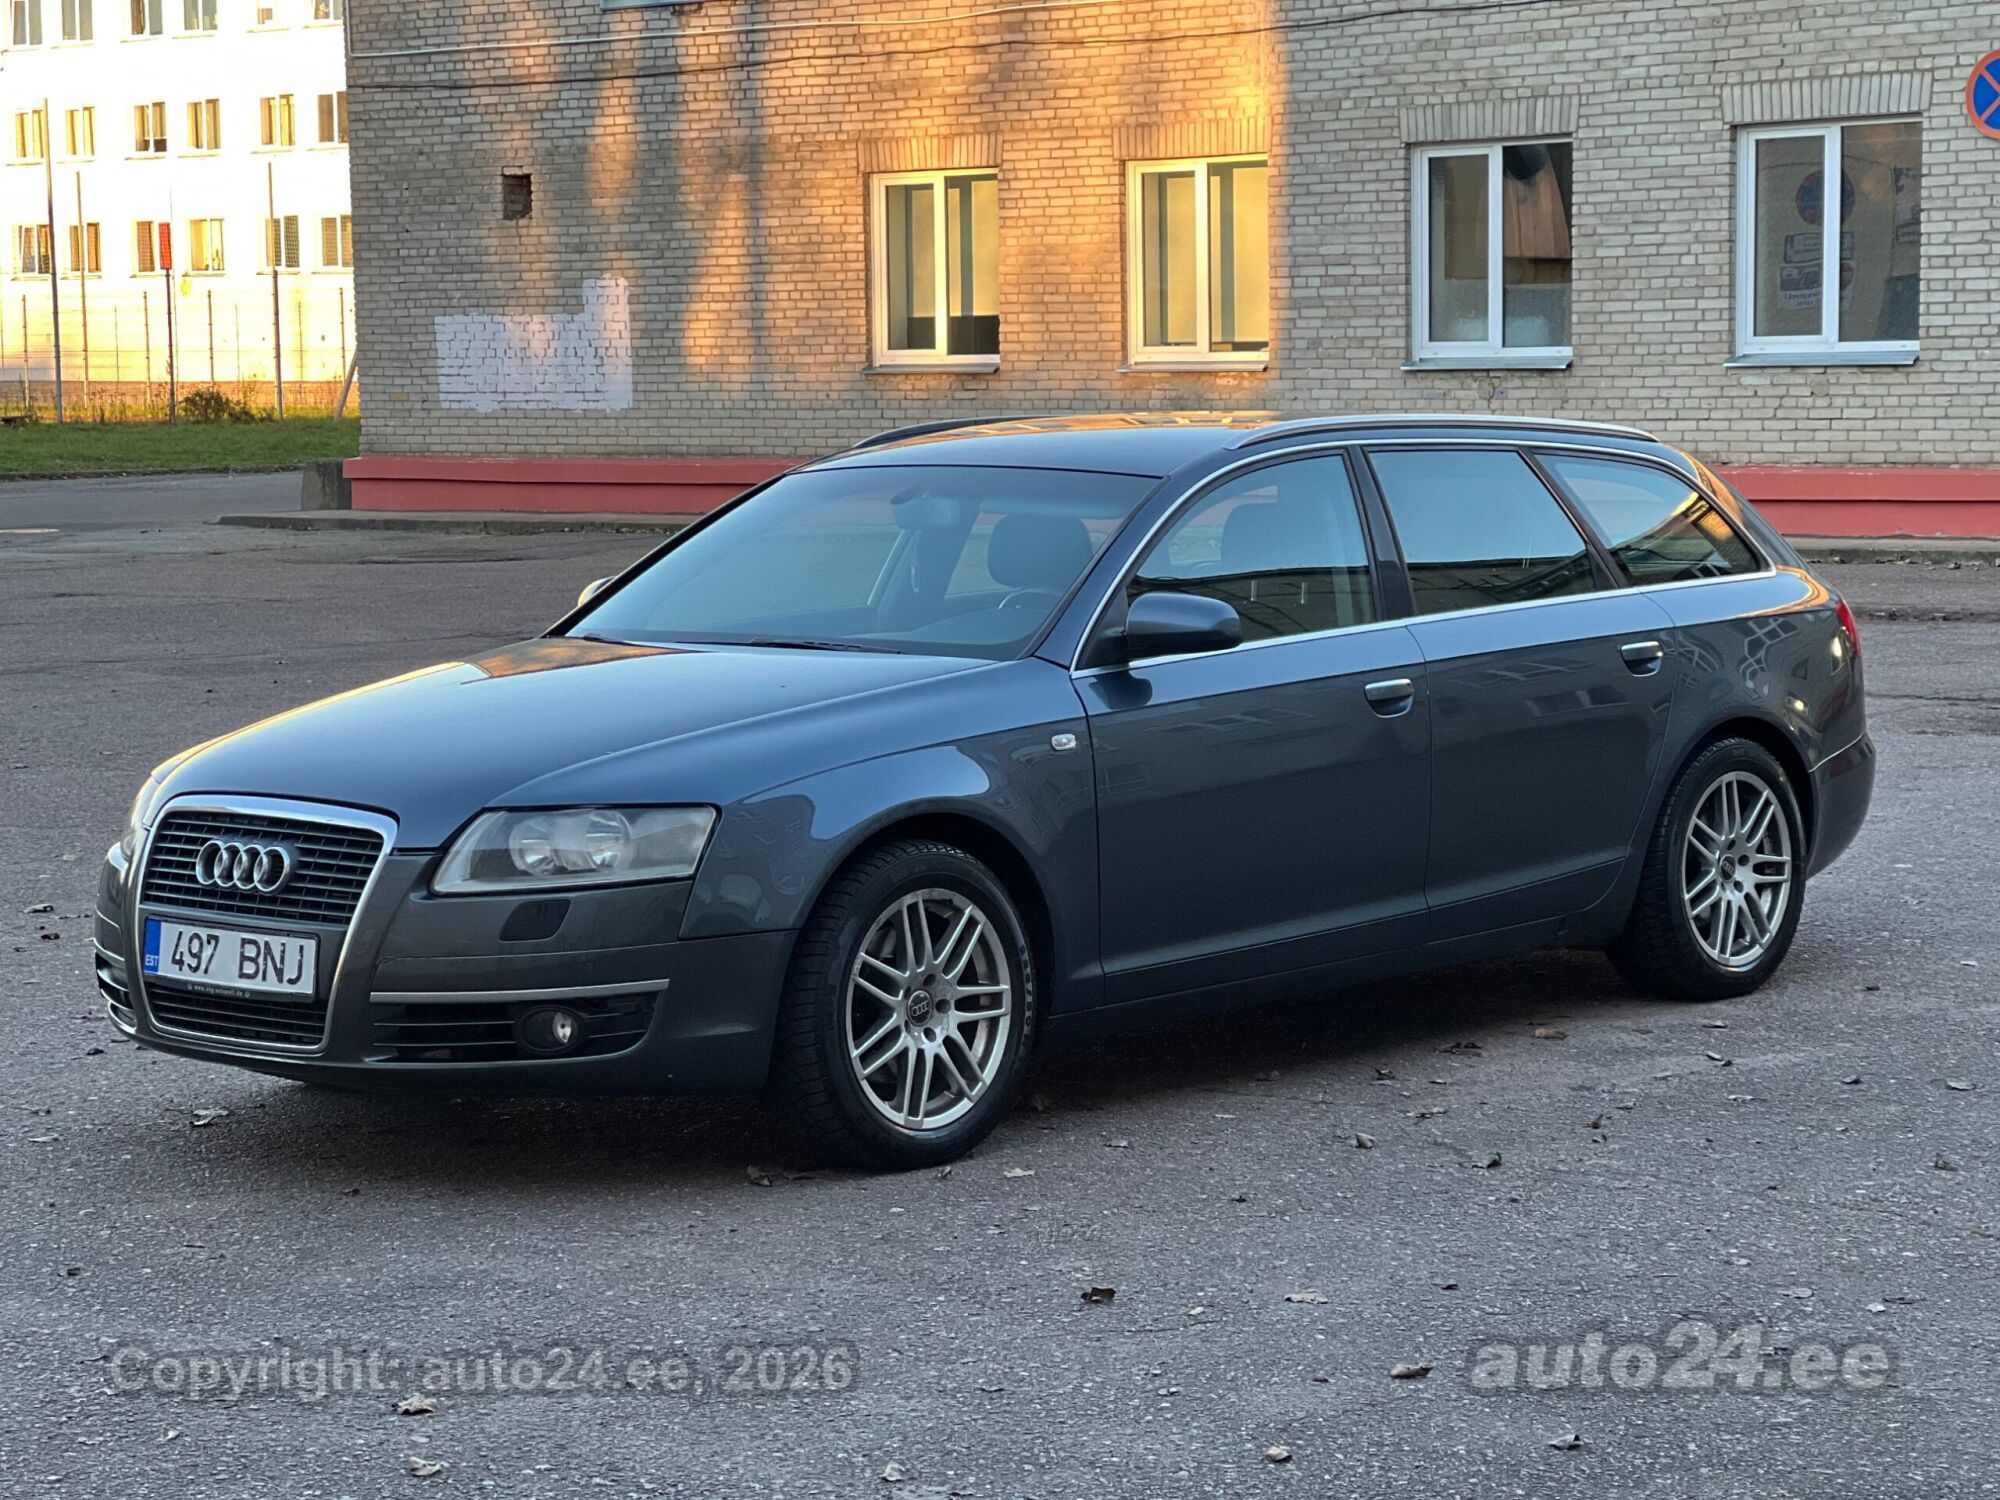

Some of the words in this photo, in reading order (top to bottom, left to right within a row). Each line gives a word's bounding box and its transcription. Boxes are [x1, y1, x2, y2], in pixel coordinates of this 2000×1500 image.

[145, 953, 159, 967] EST
[171, 930, 220, 975] 497
[238, 937, 304, 986] BNJ
